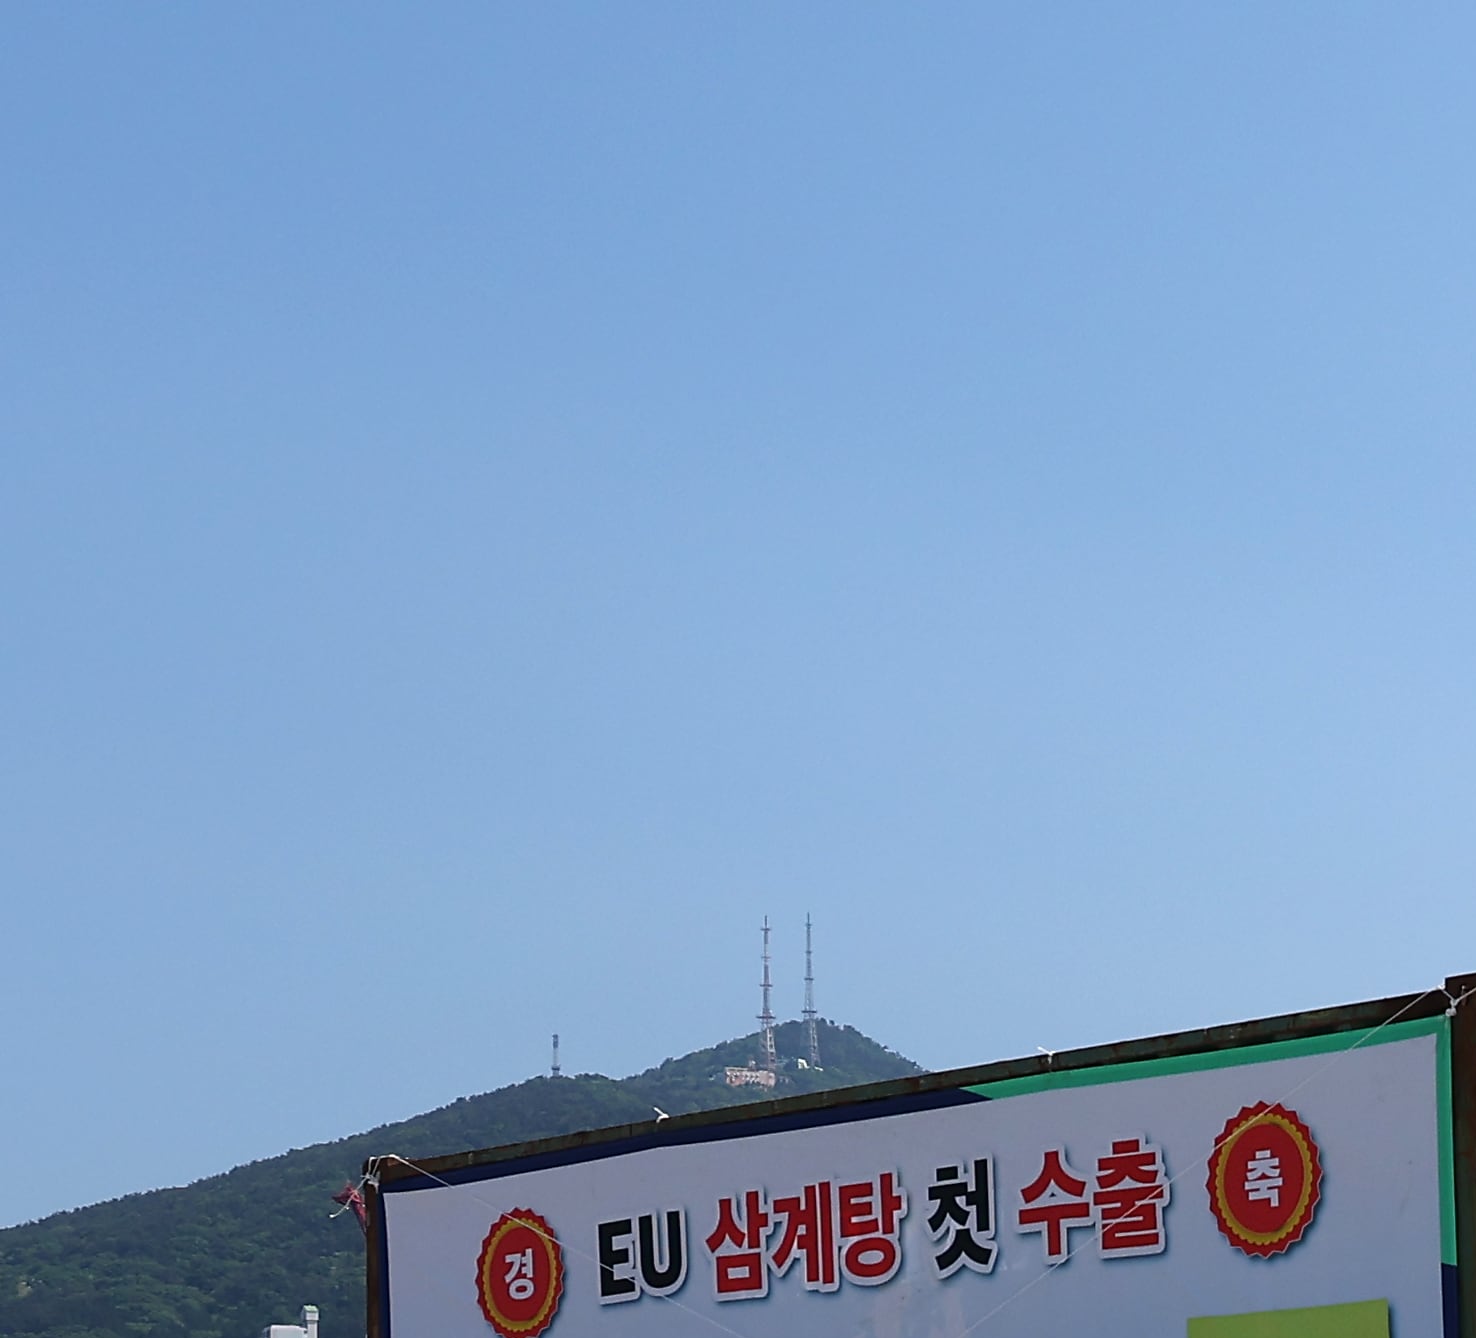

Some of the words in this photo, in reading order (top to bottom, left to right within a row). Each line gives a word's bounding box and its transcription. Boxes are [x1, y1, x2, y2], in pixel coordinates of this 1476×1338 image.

[1244, 1150, 1283, 1207] 축
[598, 1210, 685, 1298] EU
[705, 1171, 903, 1294] 삼계탕
[928, 1158, 991, 1271] 첫
[1018, 1139, 1164, 1256] 수출
[504, 1248, 535, 1300] 경
